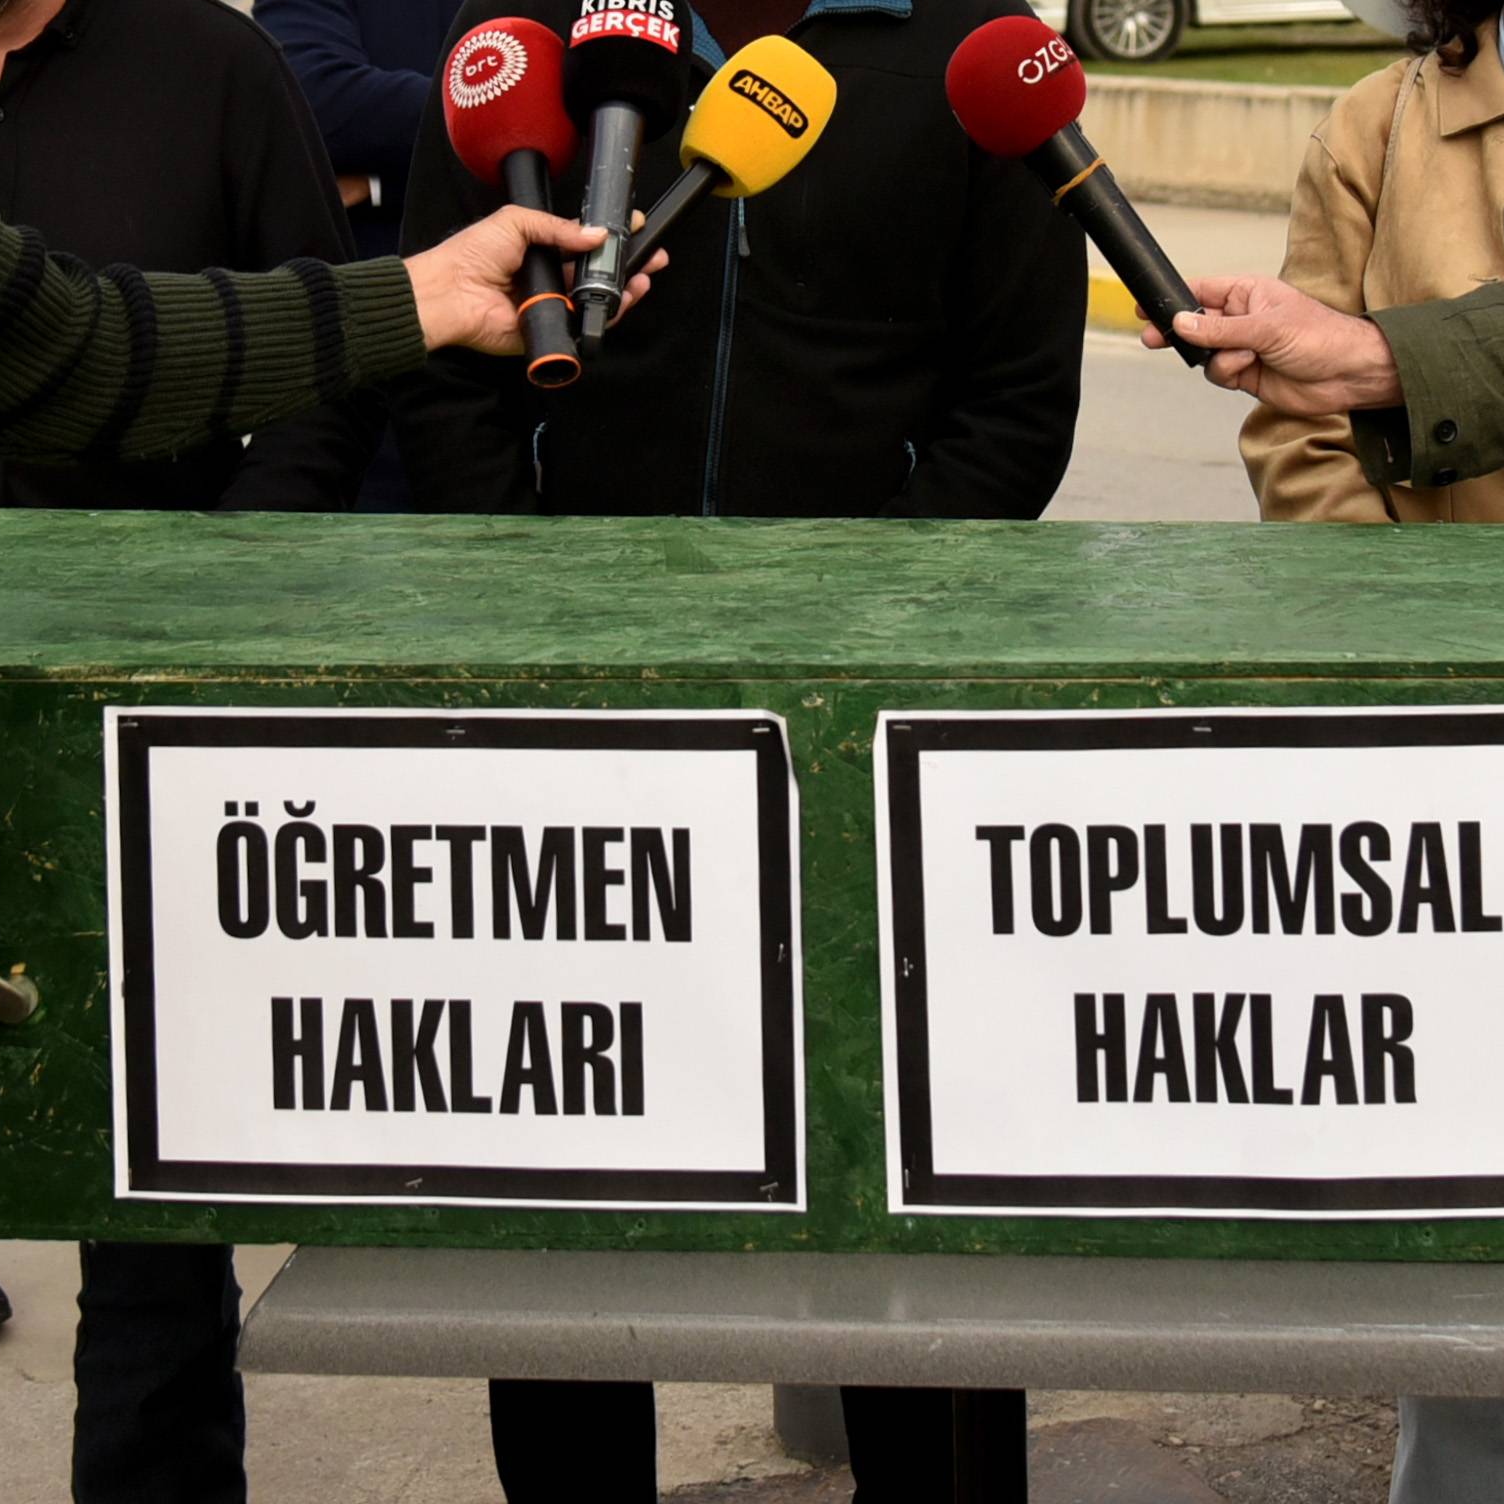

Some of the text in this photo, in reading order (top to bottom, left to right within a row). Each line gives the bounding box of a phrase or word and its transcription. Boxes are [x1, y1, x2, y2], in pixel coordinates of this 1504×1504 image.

[571, 12, 680, 48] GERÇEK
[733, 76, 804, 128] AHBAP
[215, 800, 693, 943] ÖĞRETMEN
[975, 821, 1504, 938] TOPLUMSAL
[271, 997, 645, 1116] HAKLARI
[1073, 992, 1418, 1105] HAKLAR
